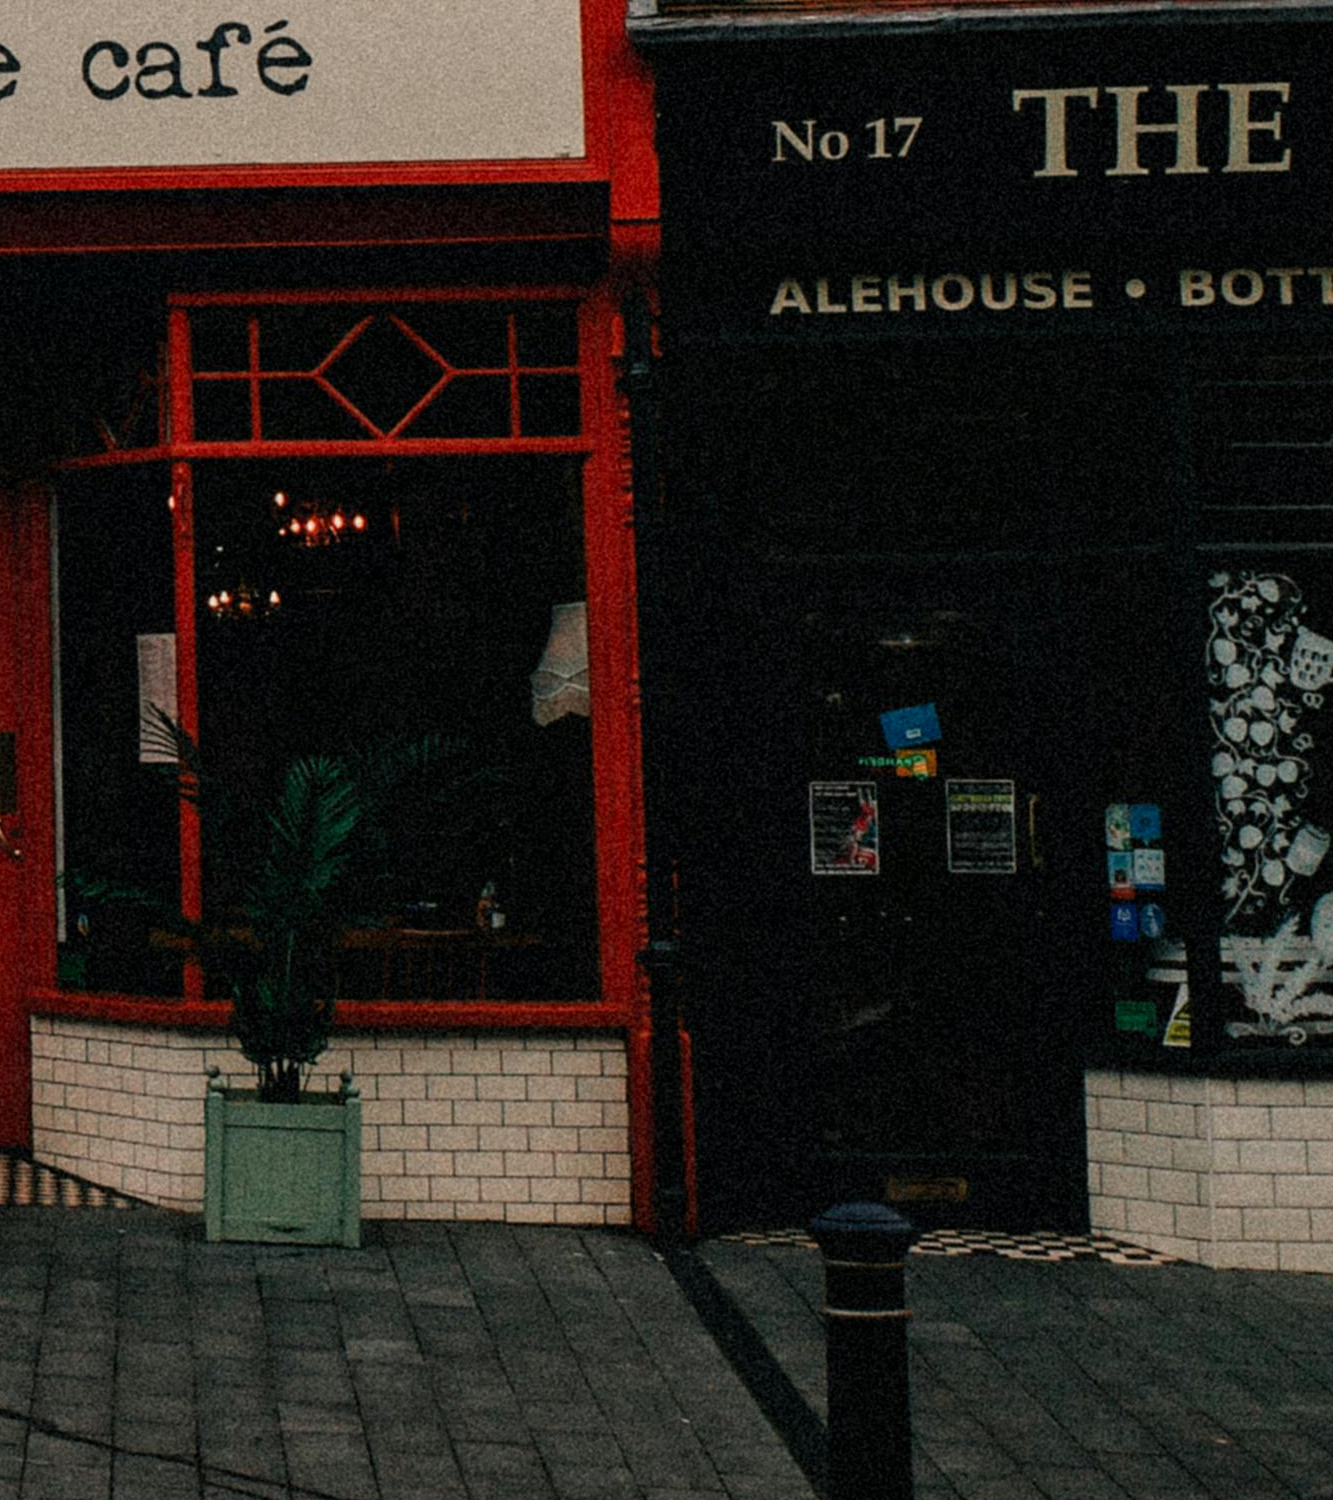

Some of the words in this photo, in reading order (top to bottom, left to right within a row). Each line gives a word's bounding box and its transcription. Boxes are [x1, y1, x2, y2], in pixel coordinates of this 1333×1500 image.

[81, 19, 314, 100] café
[771, 119, 849, 163] No
[865, 116, 923, 159] 17
[1013, 81, 1293, 178] THE
[769, 271, 1094, 316] ALEHOUSE
